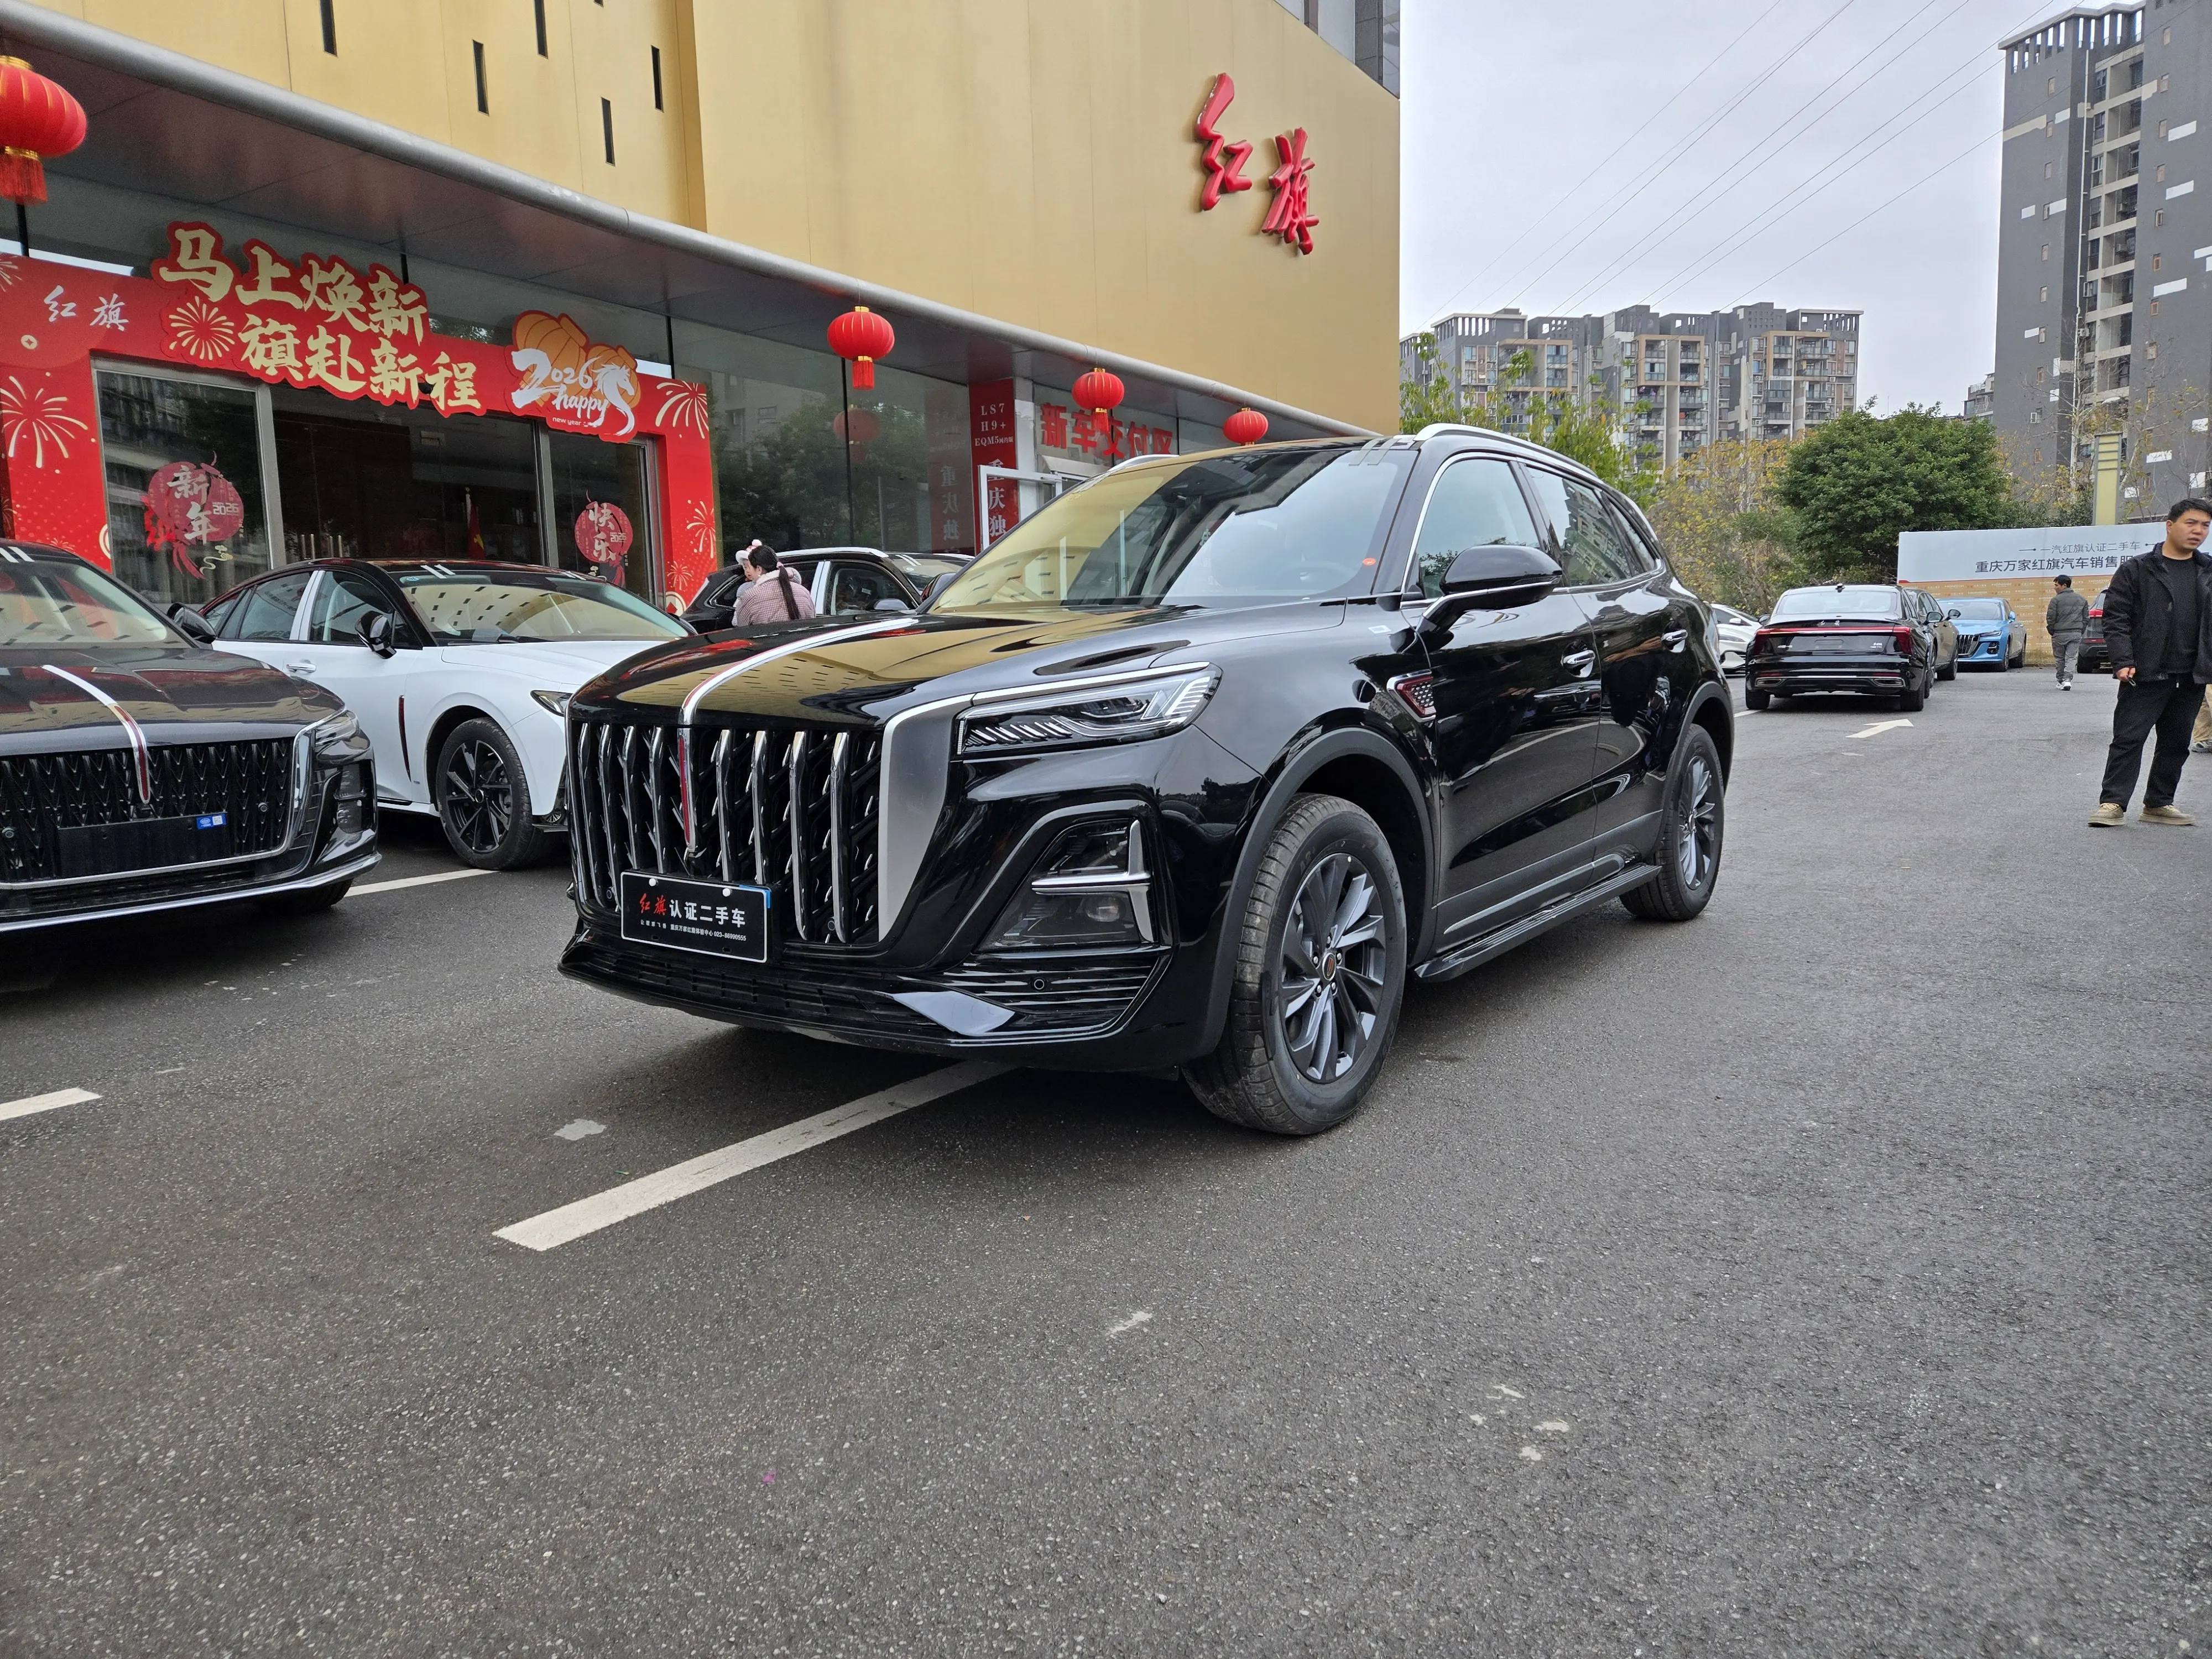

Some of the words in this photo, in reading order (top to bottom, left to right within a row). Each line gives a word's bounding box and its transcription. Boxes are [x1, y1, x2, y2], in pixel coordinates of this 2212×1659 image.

[1194, 72, 1321, 255] 红旗
[44, 285, 129, 331] 红旗
[159, 228, 427, 346] 马上焕新
[238, 313, 483, 411] 旗赴新程
[511, 348, 603, 409] 2026
[552, 384, 610, 427] happy
[167, 465, 221, 546] 新年
[213, 503, 239, 515] 2026
[588, 502, 616, 562] 快乐
